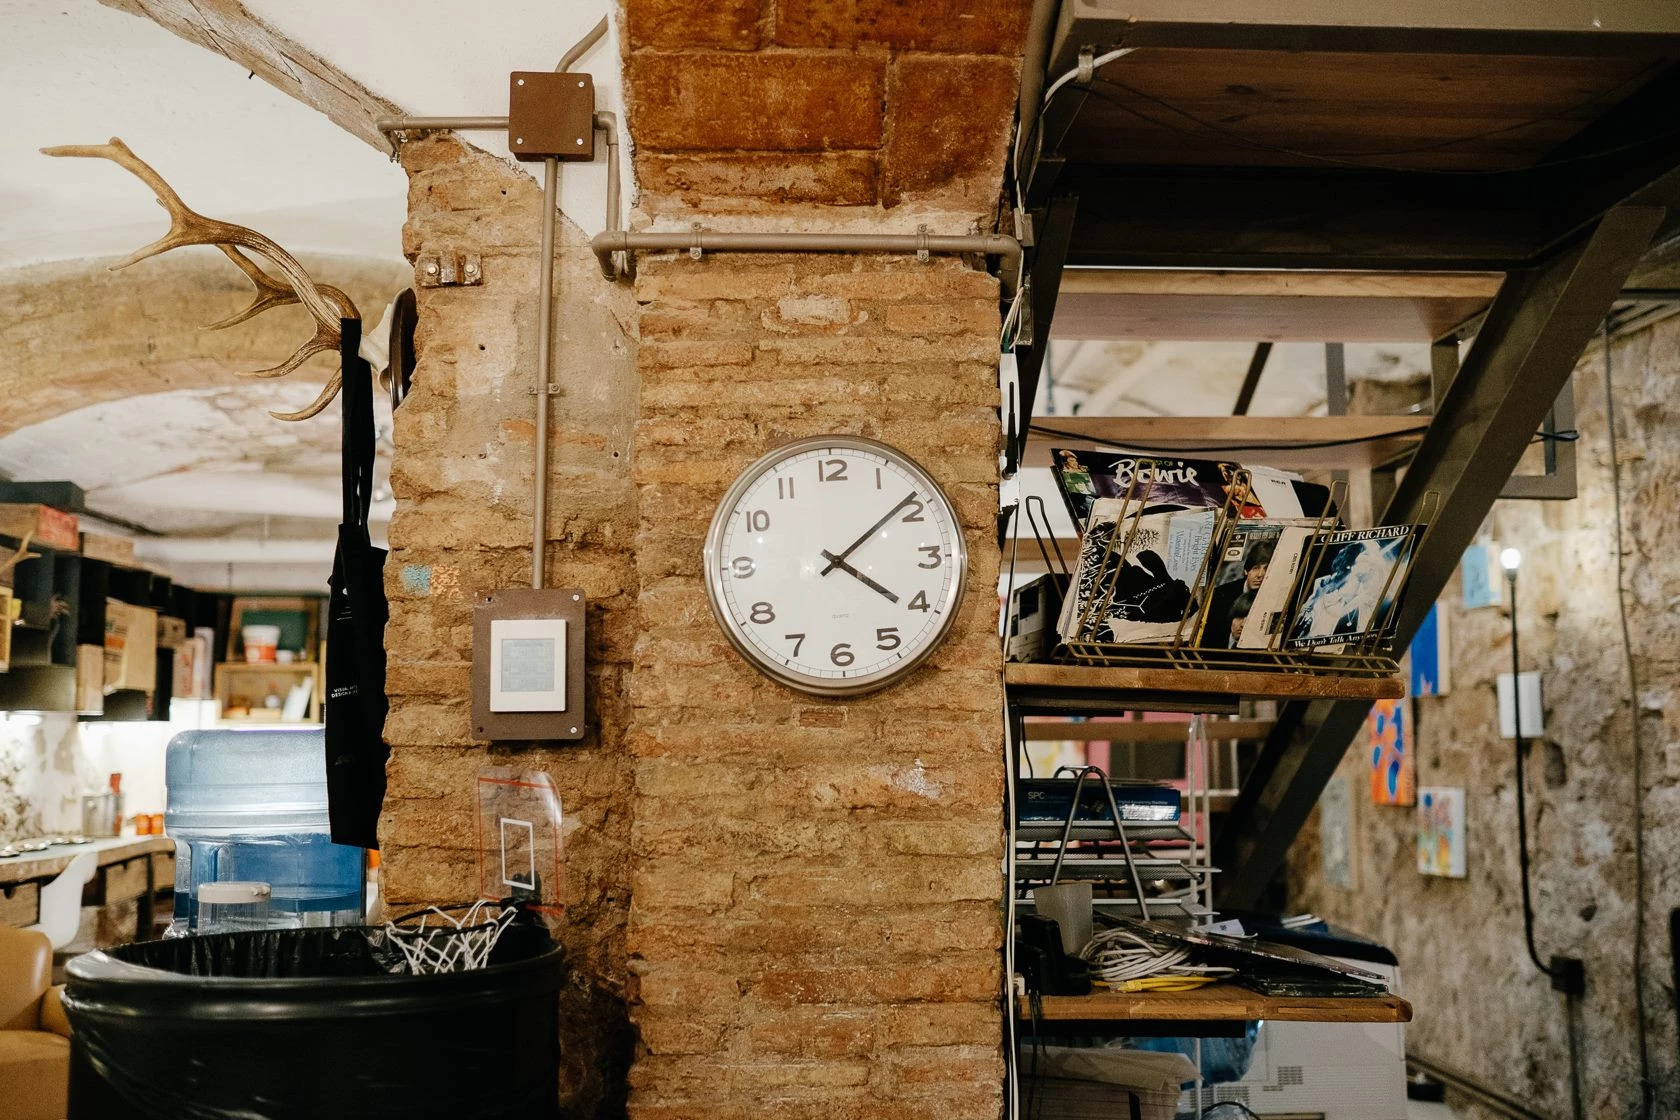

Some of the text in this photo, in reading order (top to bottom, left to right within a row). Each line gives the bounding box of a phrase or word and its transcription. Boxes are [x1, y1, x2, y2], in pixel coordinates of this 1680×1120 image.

[818, 459, 848, 482] 12
[875, 467, 882, 490] 1
[1108, 458, 1200, 488] Bowie
[778, 477, 795, 500] 11
[746, 510, 770, 533] 10
[901, 499, 925, 523] 2
[1191, 535, 1203, 555] Bright
[1321, 526, 1410, 543] CLIFF RICHARD
[732, 556, 756, 579] 9
[917, 545, 942, 569] 3
[750, 601, 776, 625] 8
[907, 590, 931, 613] 4
[785, 633, 805, 657] 7
[876, 627, 902, 650] 5
[1294, 639, 1306, 648] We
[1329, 635, 1345, 644] Talk
[830, 643, 855, 667] 6
[1027, 791, 1046, 800] SPC
